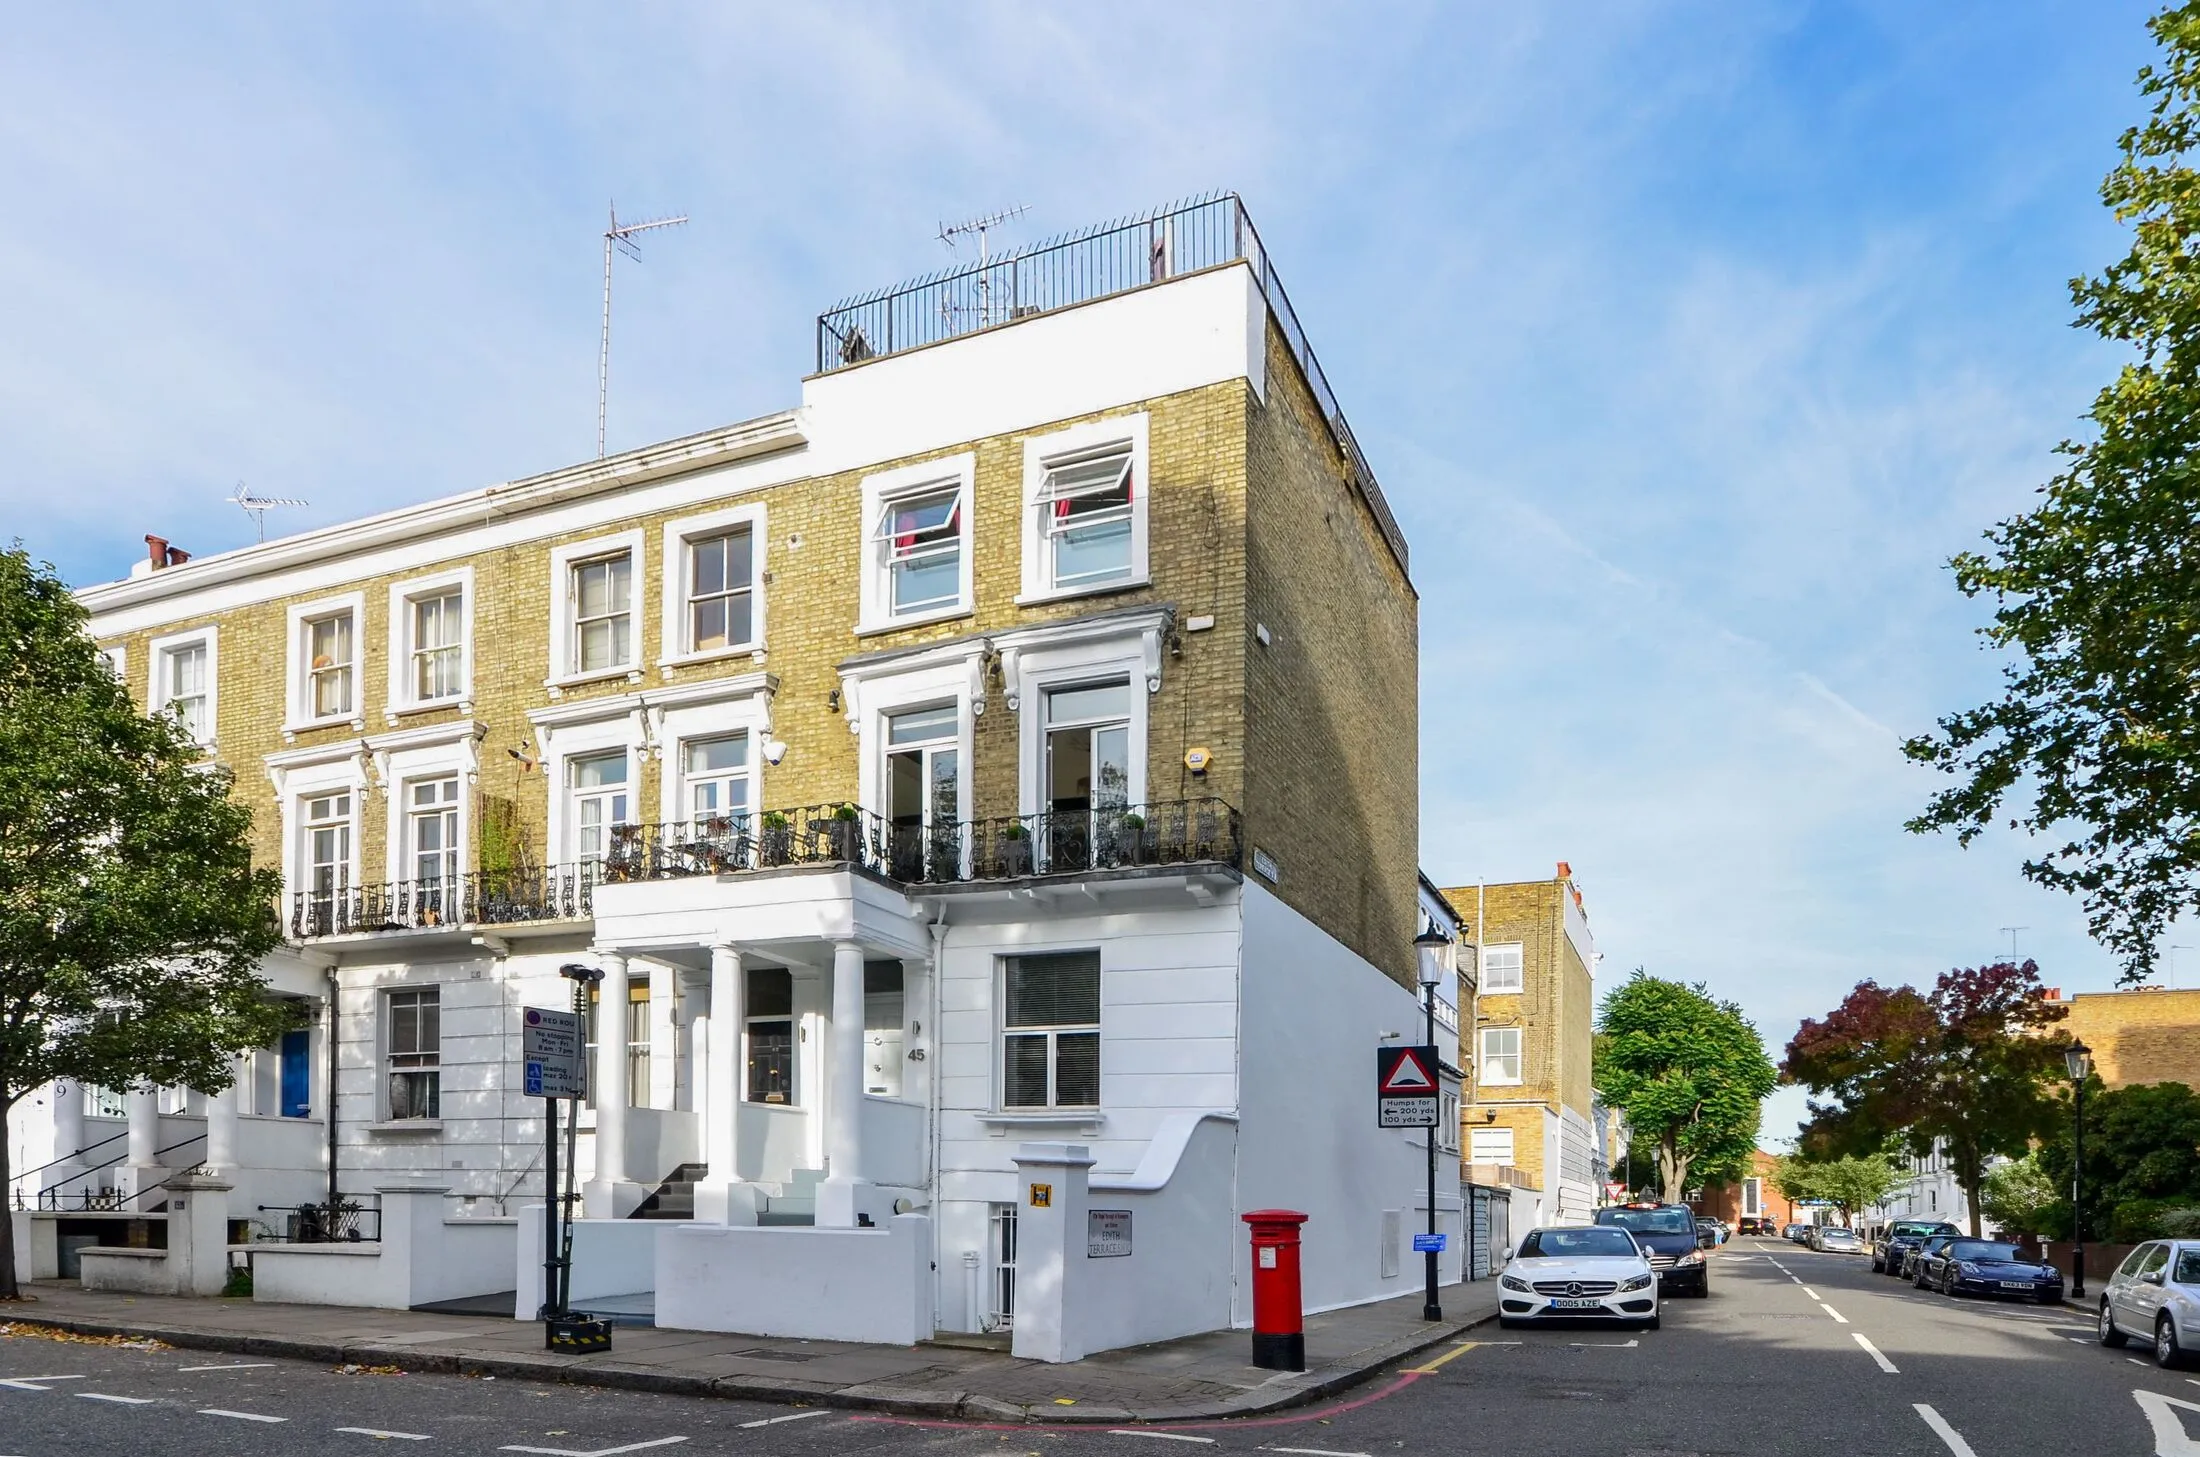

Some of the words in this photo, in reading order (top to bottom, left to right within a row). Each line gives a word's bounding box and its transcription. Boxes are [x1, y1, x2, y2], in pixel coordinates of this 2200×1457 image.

[541, 1038, 556, 1046] Mon
[908, 1048, 925, 1061] 45
[1420, 1107, 1435, 1115] yds
[1402, 1116, 1417, 1124] yds
[1102, 1231, 1121, 1241] EDITH
